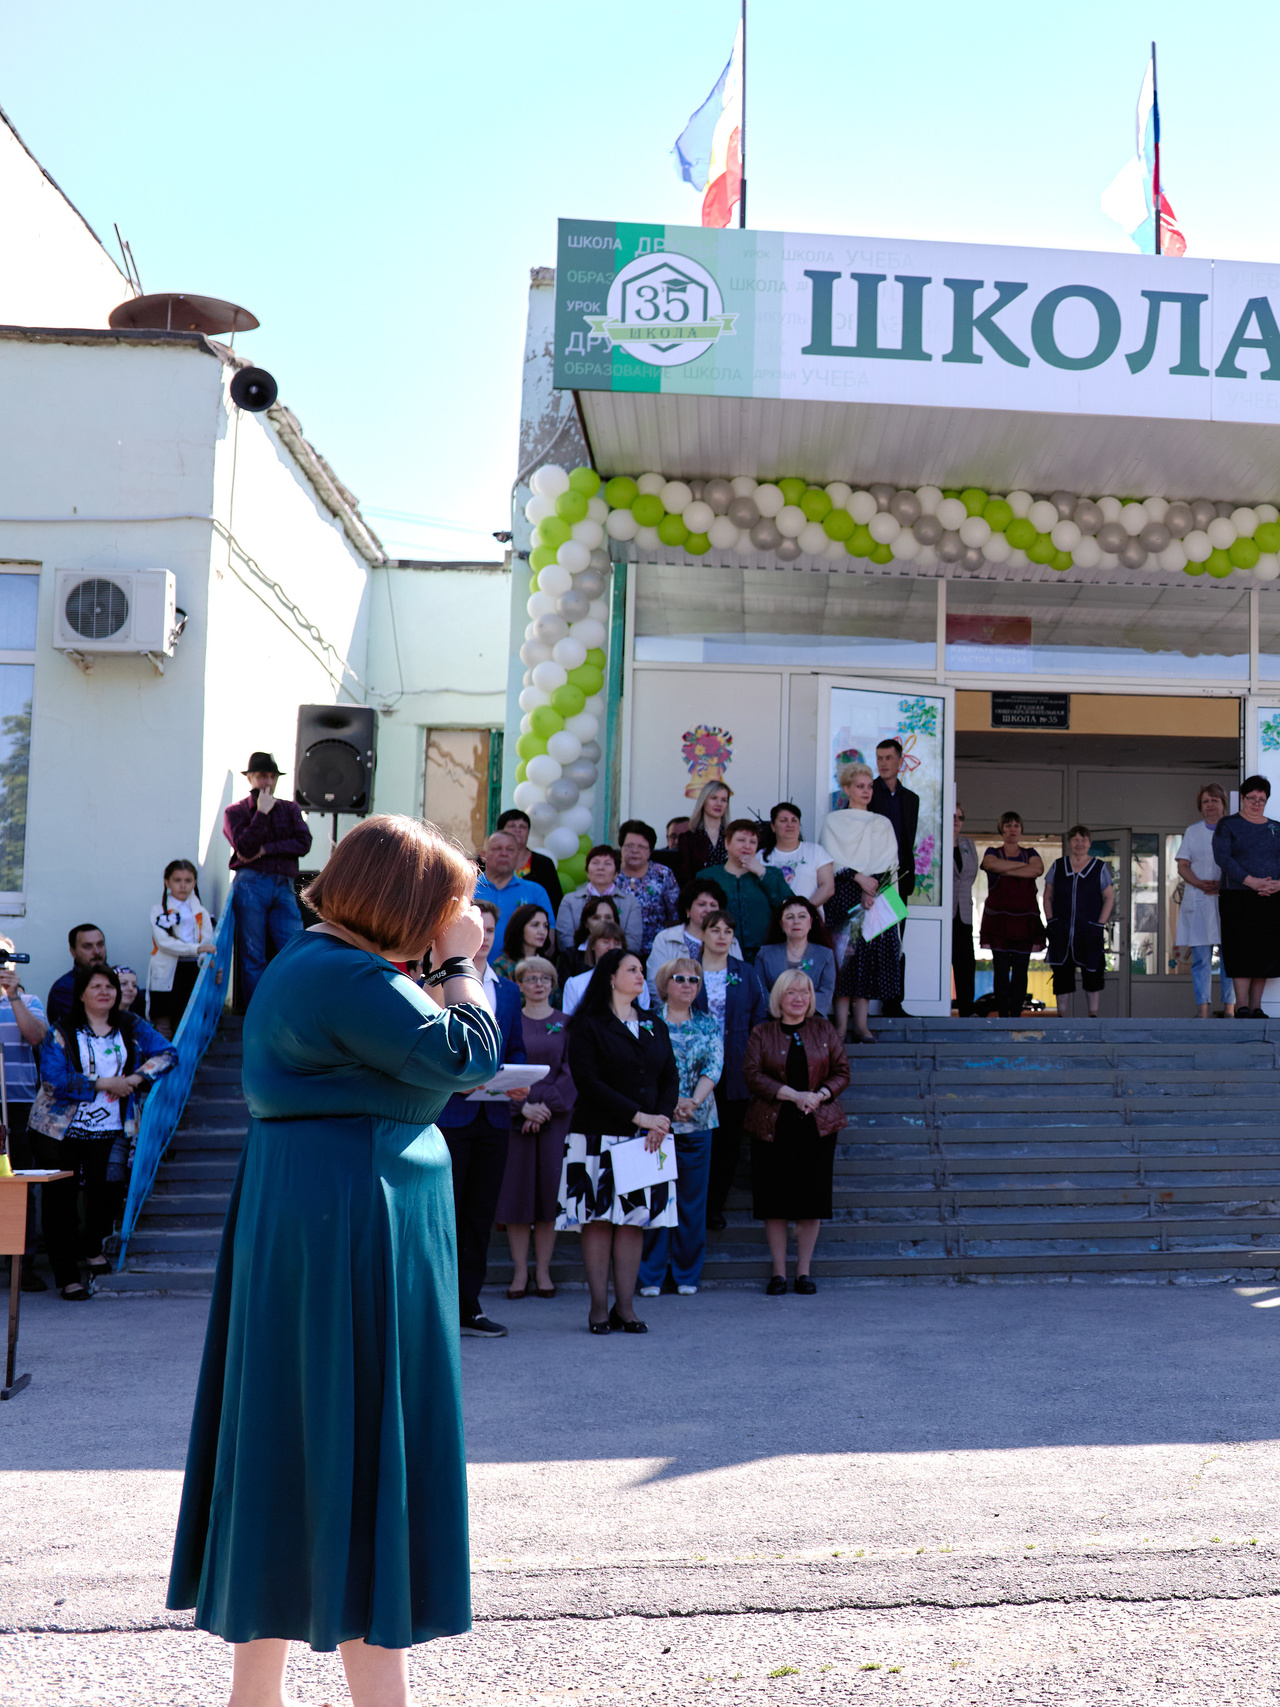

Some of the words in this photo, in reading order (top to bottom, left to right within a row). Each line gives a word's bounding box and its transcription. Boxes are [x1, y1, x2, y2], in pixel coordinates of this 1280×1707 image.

[567, 234, 622, 251] ШКОЛА
[782, 249, 835, 263] ШКОЛА
[846, 248, 914, 270] УЧЕБА
[729, 277, 788, 294] ШКОЛА
[566, 300, 601, 313] УРОК
[635, 285, 690, 322] 35
[629, 327, 699, 340] ШКОЛА
[563, 361, 672, 379] ОБРАЗОВАНИЕ
[683, 366, 742, 382] ШКОЛА
[754, 370, 797, 381] ДРУЗЬЯ
[801, 367, 870, 389] УЧЕБА
[1002, 715, 1037, 723] ШКОЛА
